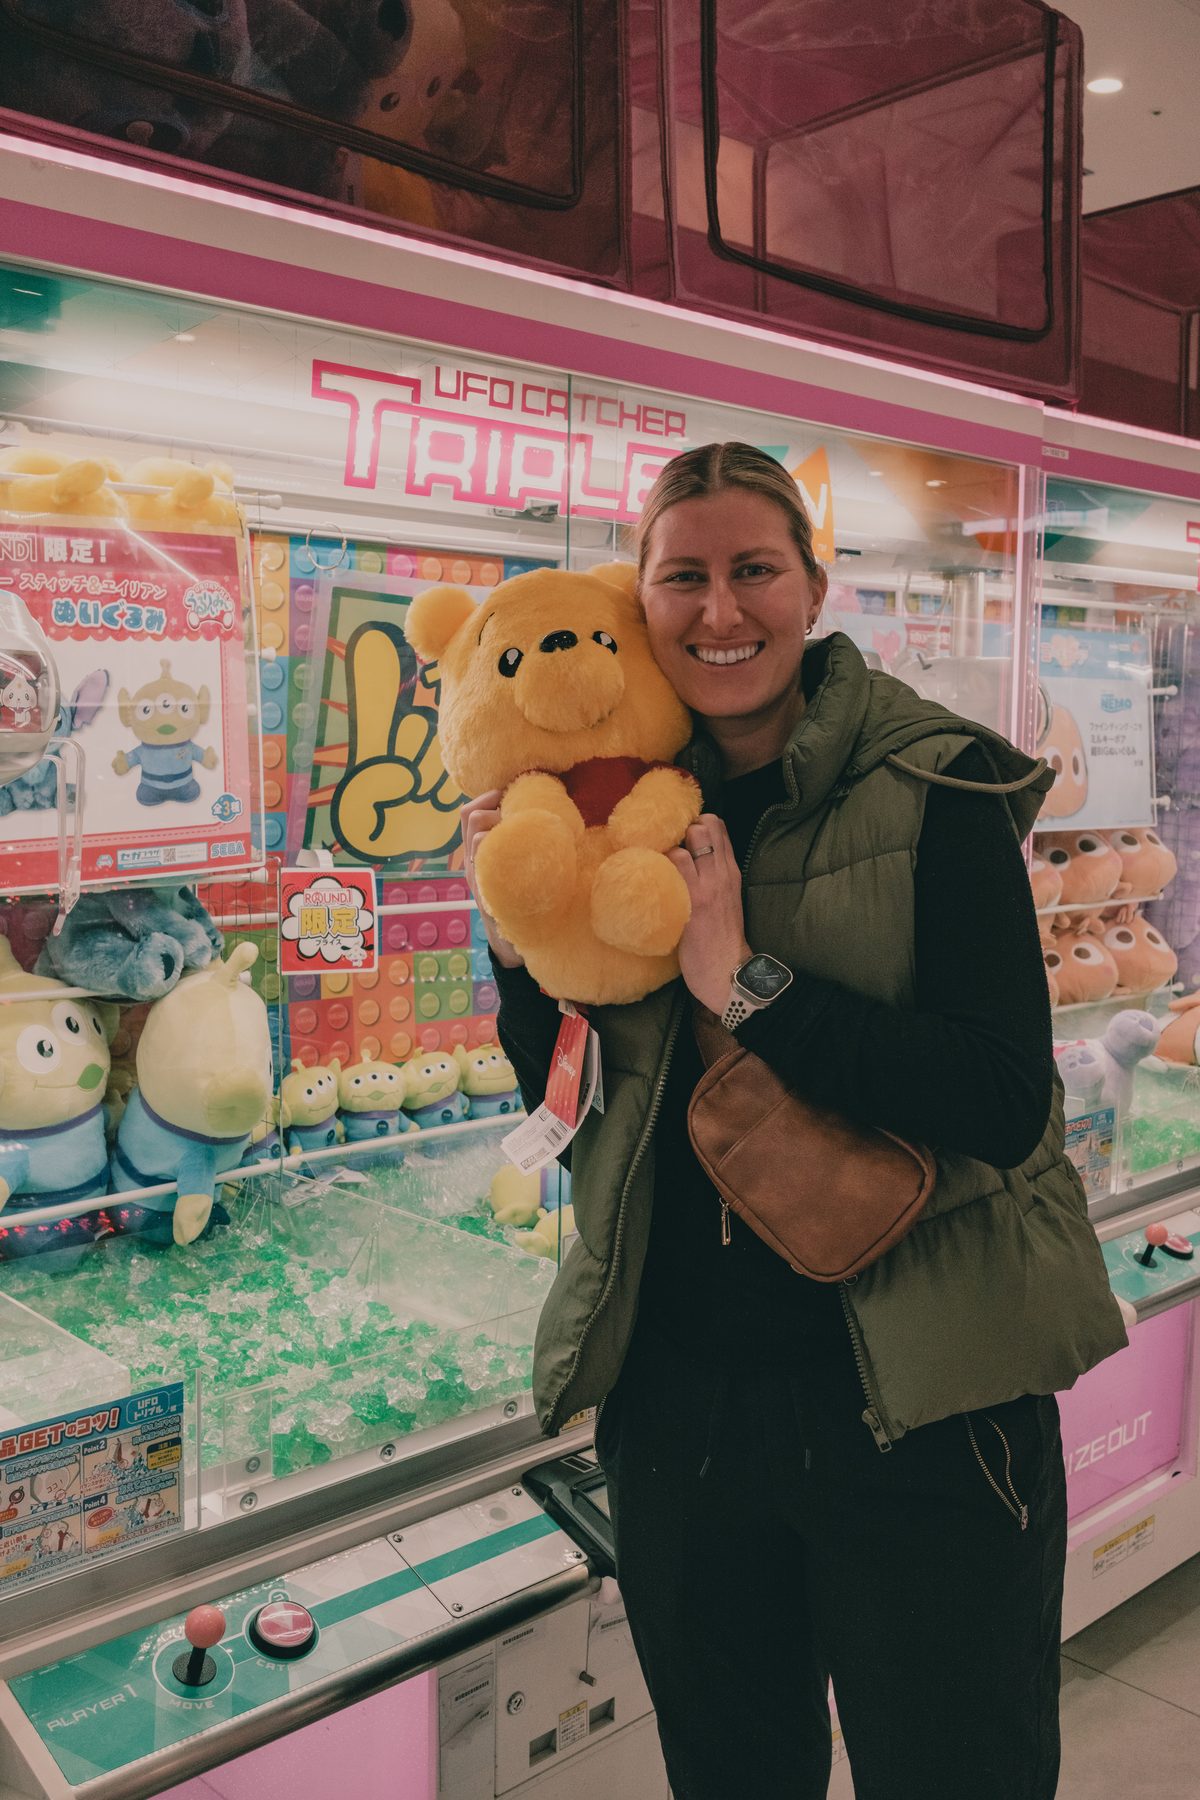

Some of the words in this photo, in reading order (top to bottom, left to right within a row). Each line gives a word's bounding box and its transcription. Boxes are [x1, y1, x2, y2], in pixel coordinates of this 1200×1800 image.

[434, 366, 514, 410] UFO
[521, 384, 686, 438] CATCHER
[312, 359, 690, 526] TRIPLE
[53, 598, 166, 633] ぬいぐるみ
[211, 841, 245, 858] SEGA
[299, 907, 359, 937] 限定
[138, 1396, 158, 1409] UFO
[1064, 1410, 1153, 1476] IZEOUT
[46, 1692, 127, 1733] PLAYER
[123, 1683, 139, 1699] 1
[168, 1698, 216, 1711] MOVE
